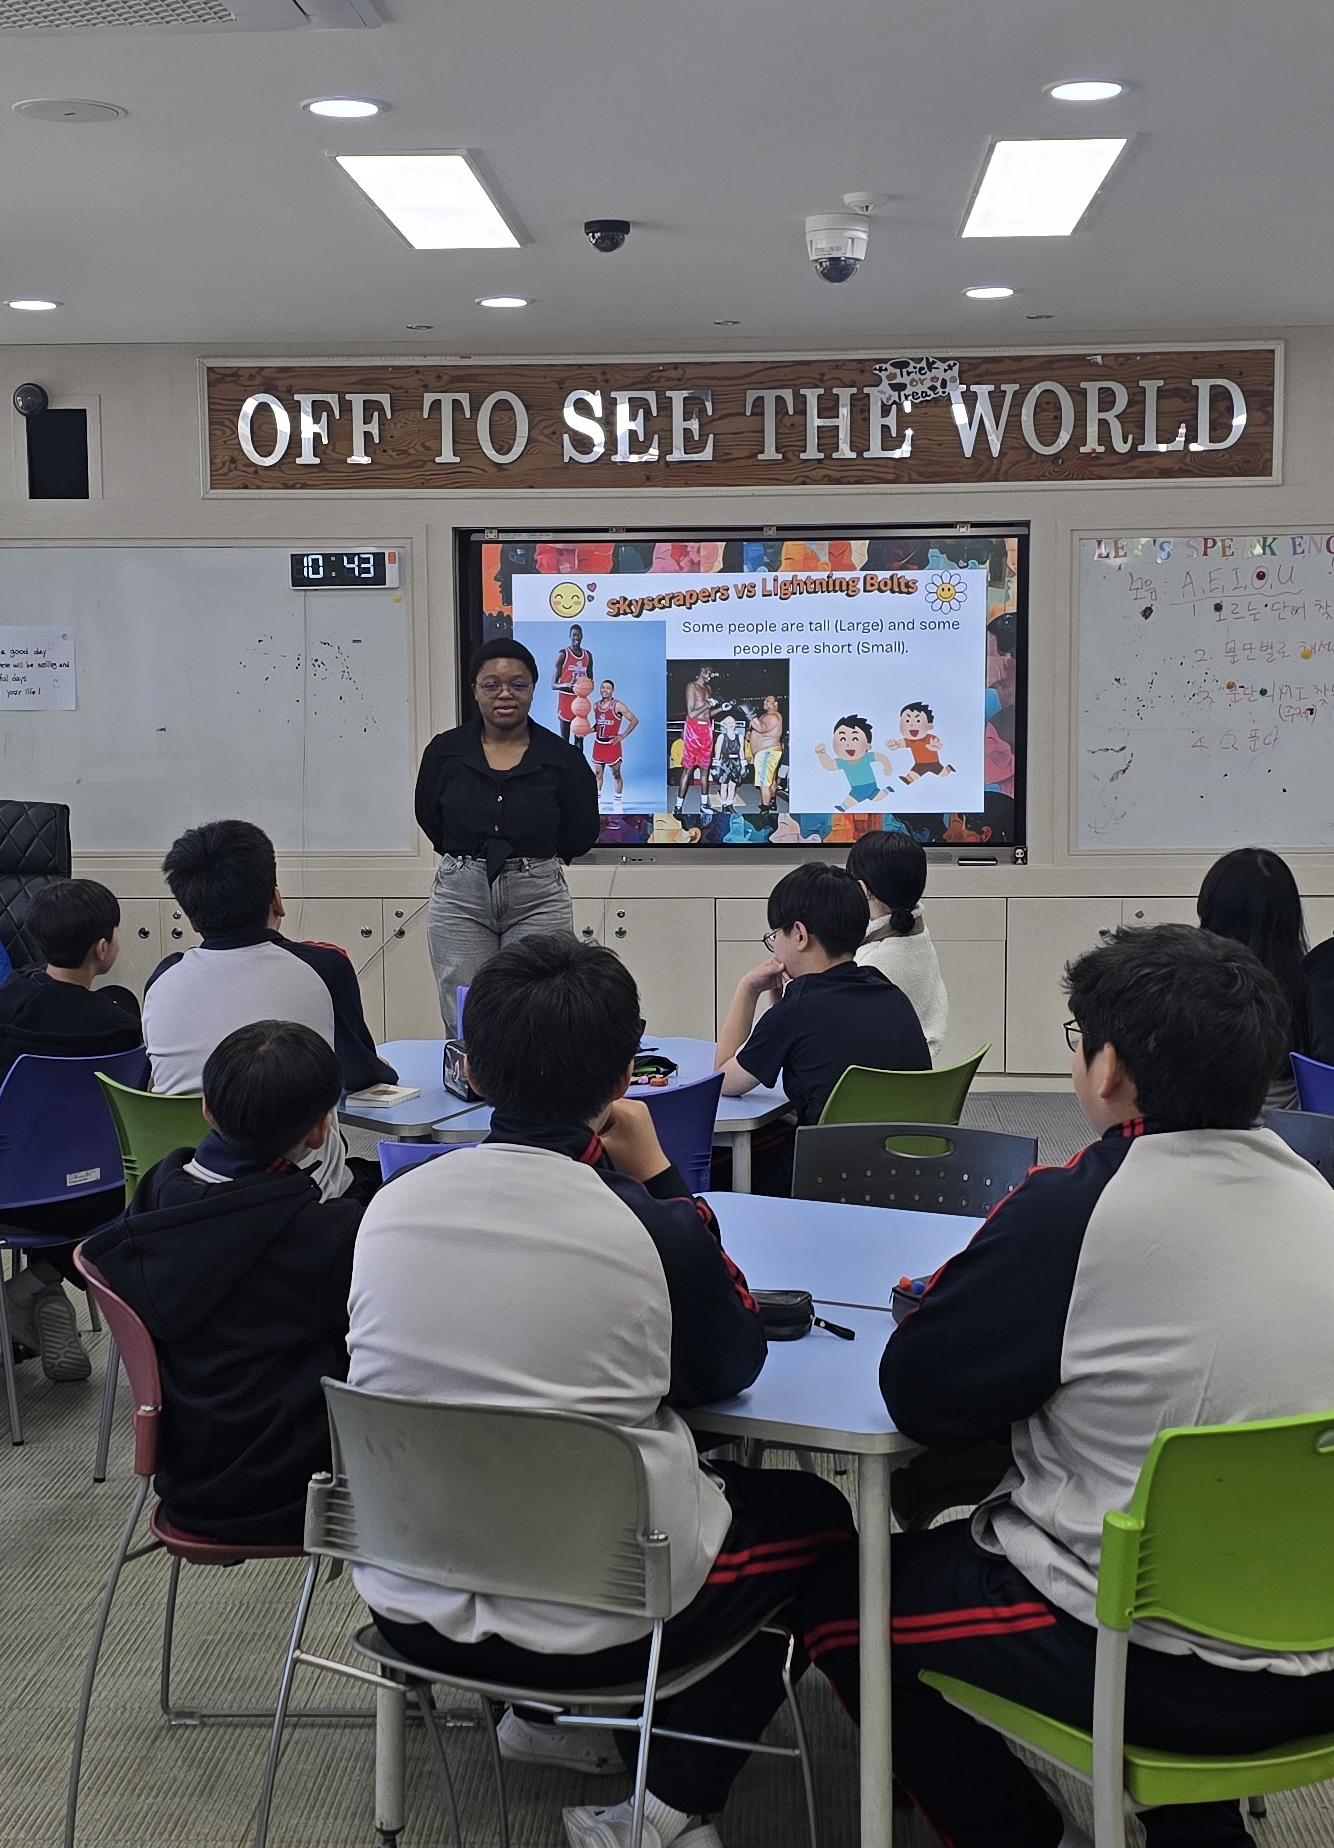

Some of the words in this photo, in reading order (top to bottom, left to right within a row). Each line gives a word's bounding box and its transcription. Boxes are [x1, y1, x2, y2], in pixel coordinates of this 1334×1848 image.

[889, 356, 940, 378] Trick
[888, 377, 948, 402] Treat!
[909, 378, 927, 388] or
[237, 392, 392, 467] OFF
[422, 390, 529, 464] TO
[563, 389, 714, 464] SEE
[746, 387, 914, 460] THE
[948, 378, 1247, 458] WORLD
[1186, 536, 1279, 558] SPEAK
[303, 553, 375, 579] 10:43
[606, 584, 730, 618] Skyscrapers
[733, 582, 757, 599] vs
[761, 572, 861, 600] Lightning
[862, 572, 919, 596] Bolts
[682, 621, 724, 633] Some
[728, 619, 777, 634] people
[781, 621, 805, 632] are
[808, 619, 830, 632] tall
[834, 618, 884, 634] (Large)
[888, 618, 915, 631] and
[919, 620, 960, 631] some
[10, 648, 29, 658] good
[34, 648, 47, 658] day
[733, 642, 782, 657] people
[786, 643, 810, 654] are
[813, 642, 853, 654] short
[856, 641, 909, 655] (Small).
